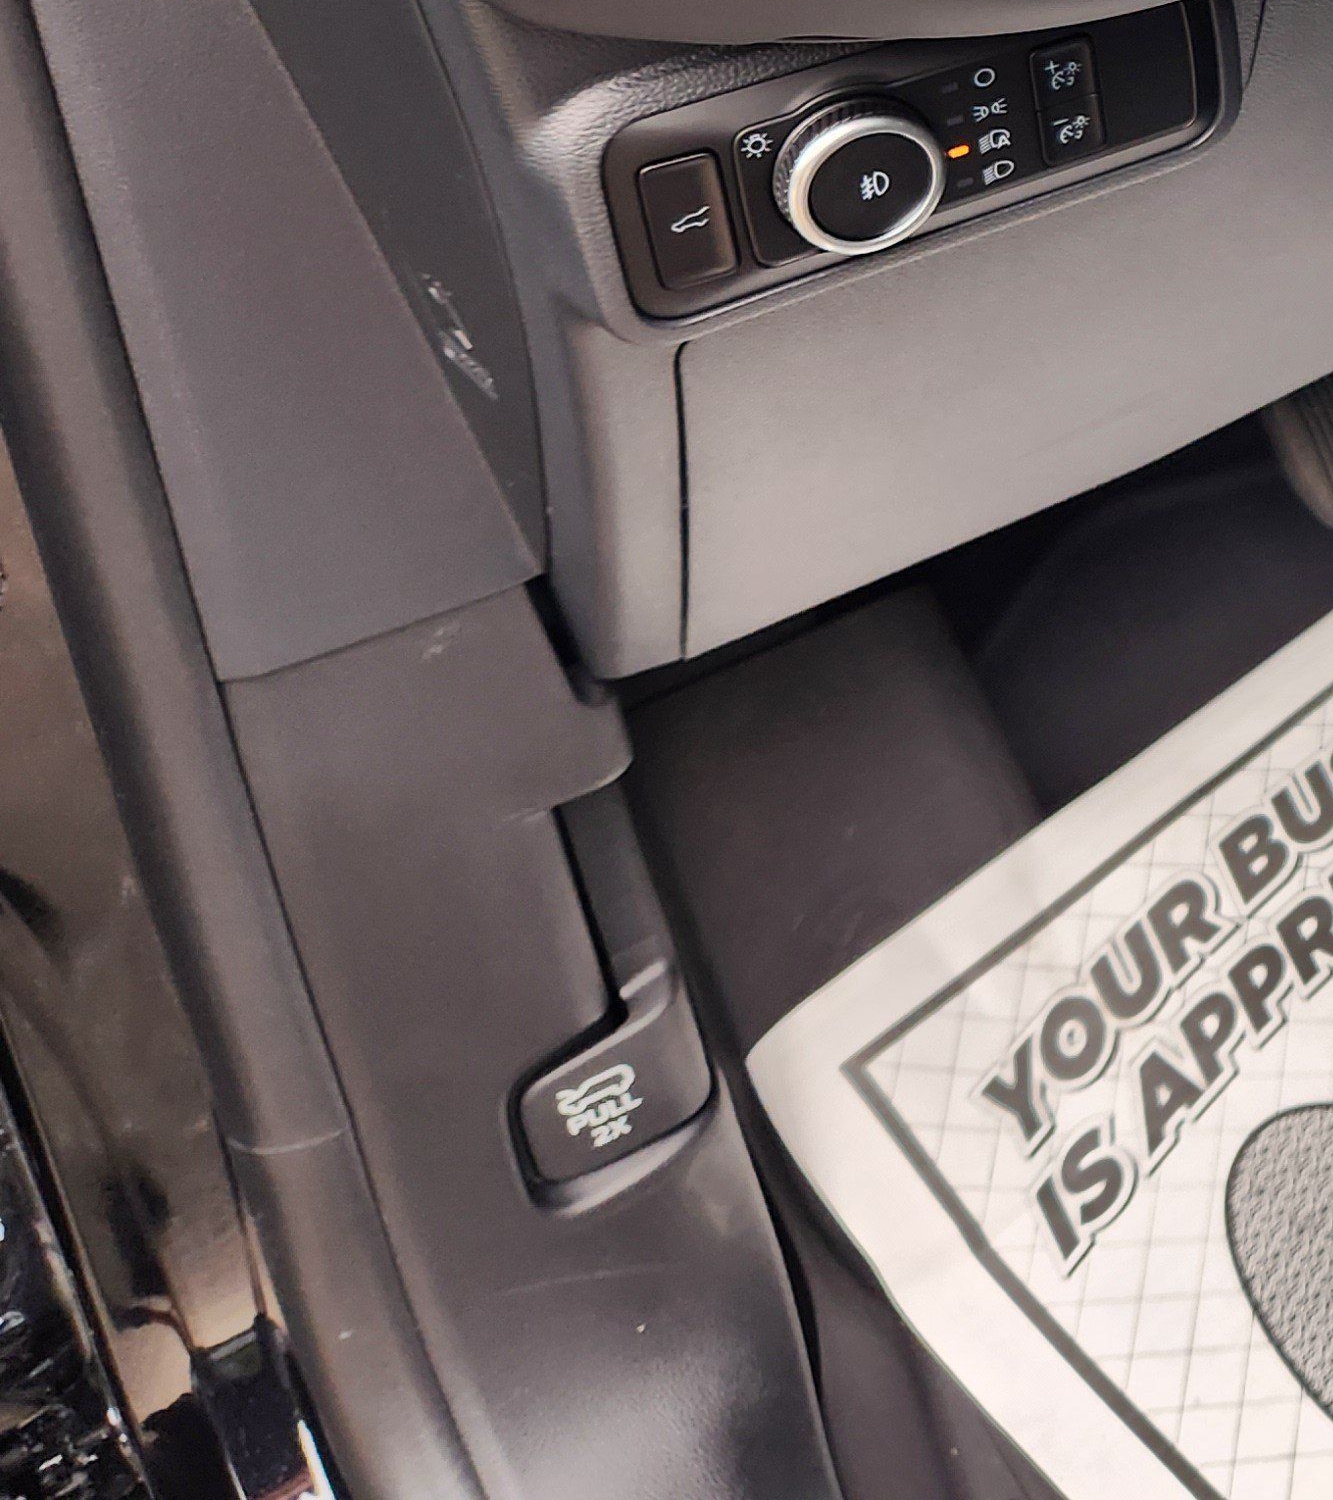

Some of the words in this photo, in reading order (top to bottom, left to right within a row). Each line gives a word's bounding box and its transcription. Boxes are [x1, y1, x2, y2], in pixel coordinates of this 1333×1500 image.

[982, 873, 1230, 1148] YOUR
[566, 1092, 644, 1137] PULL
[590, 1114, 633, 1148] 2X
[1032, 1122, 1132, 1268] IS
